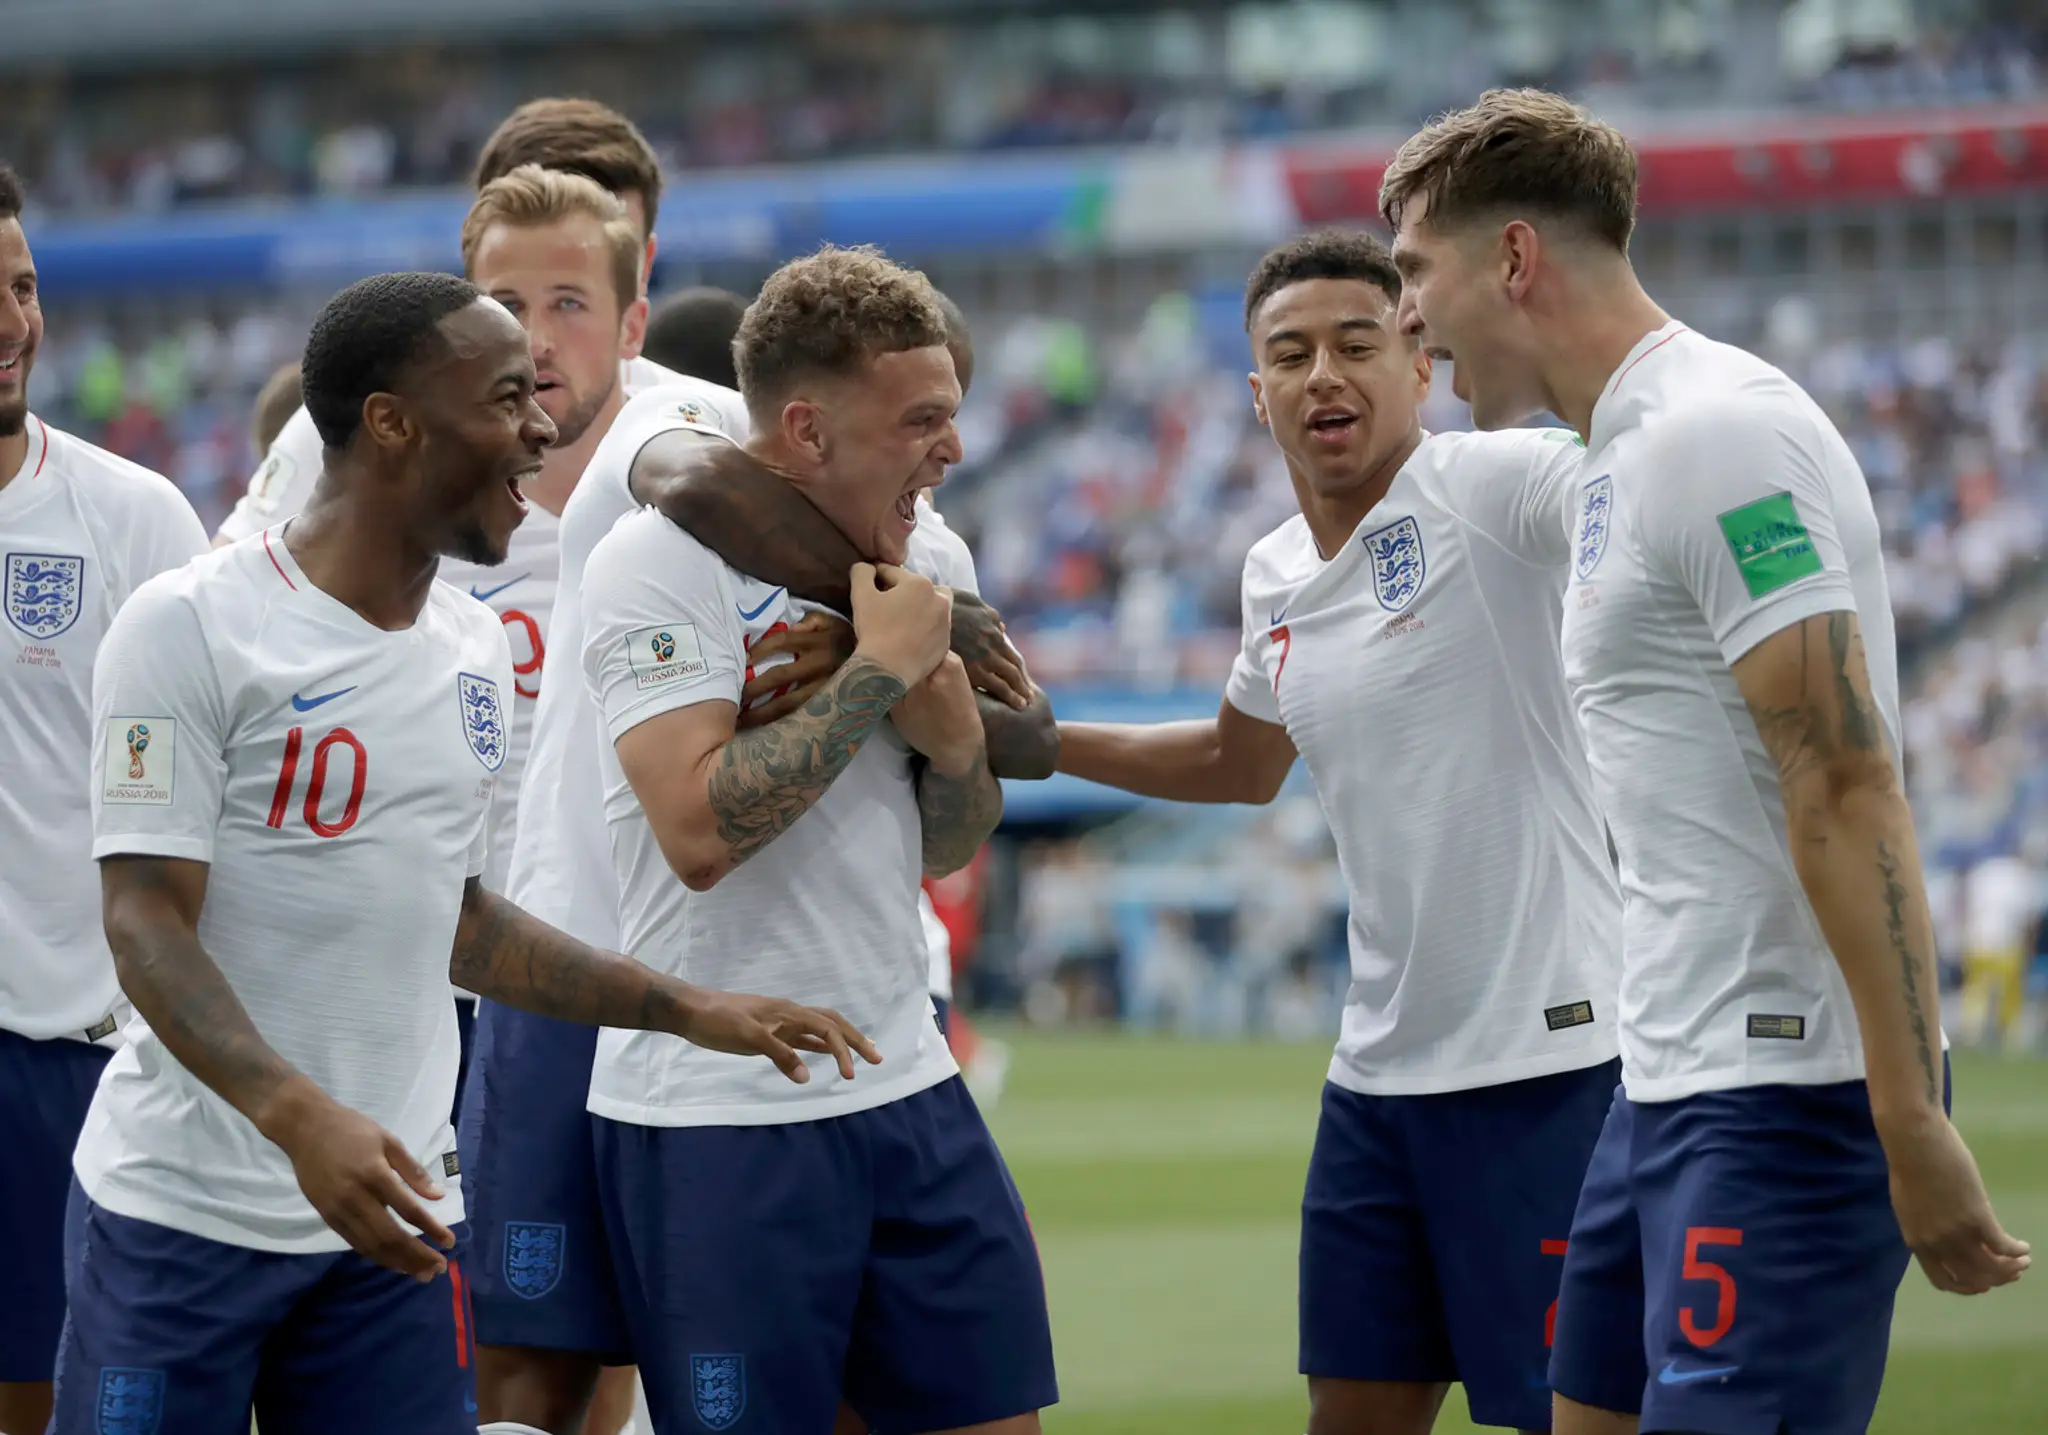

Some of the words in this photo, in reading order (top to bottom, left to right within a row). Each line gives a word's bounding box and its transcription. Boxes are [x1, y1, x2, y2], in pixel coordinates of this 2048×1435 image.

[1386, 611, 1416, 629] PANAMA
[24, 645, 56, 657] PANAMA
[500, 609, 545, 698] 9
[640, 669, 679, 684] RUSSIA
[679, 662, 703, 674] 2018
[1268, 625, 1291, 698] 7
[105, 788, 141, 799] RUSSIA
[143, 789, 169, 800] 2018
[267, 726, 367, 838] 10
[1678, 1226, 1743, 1347] 5
